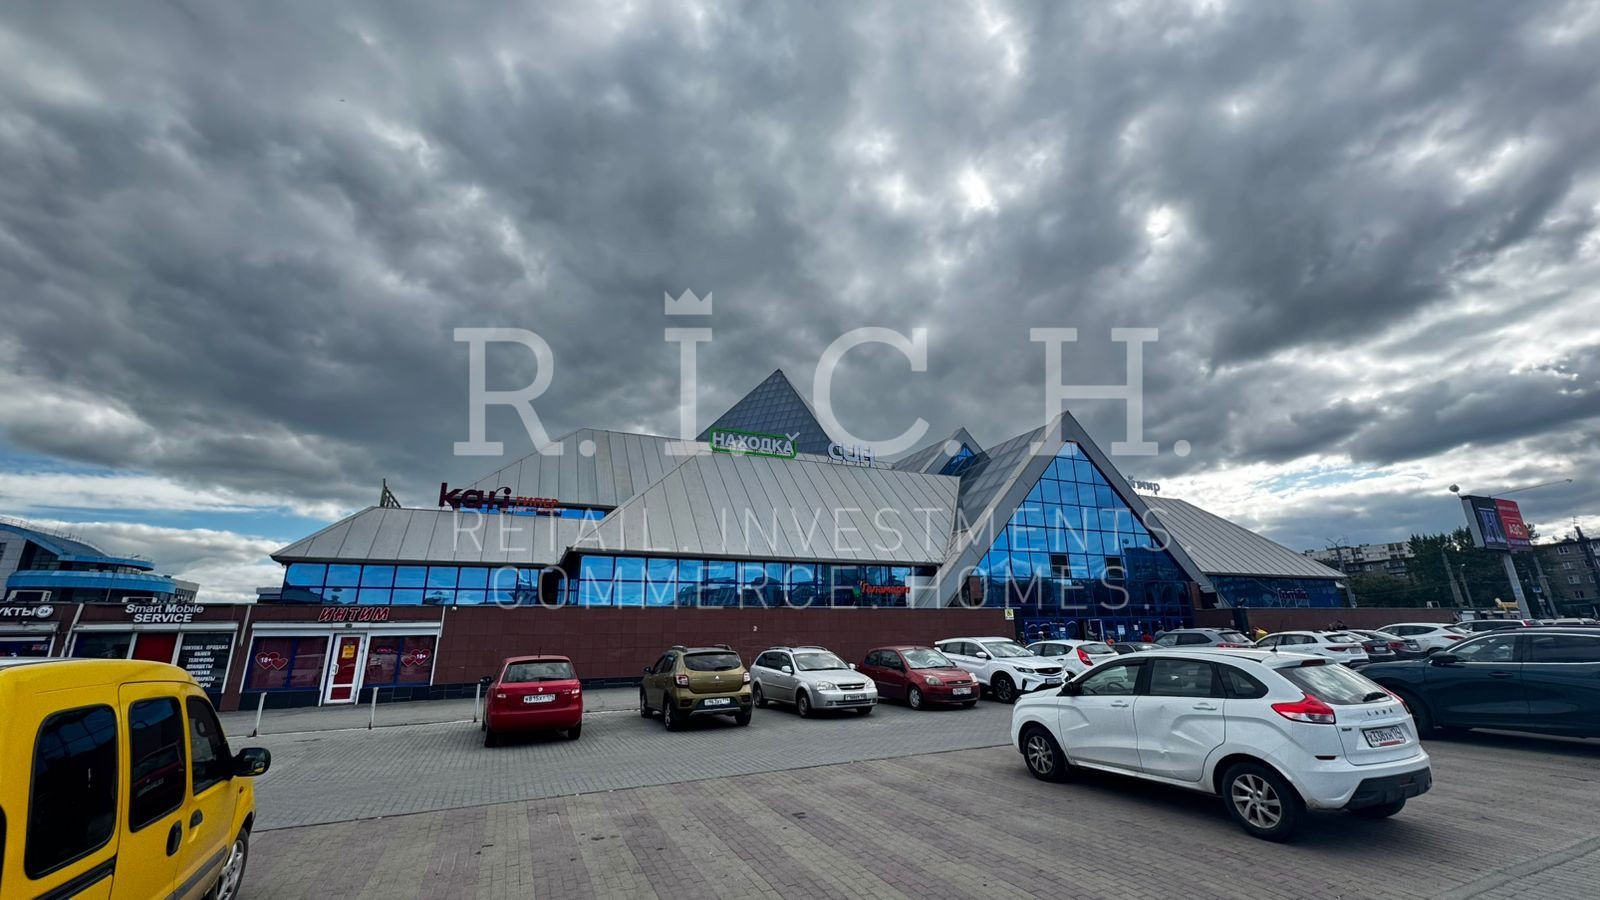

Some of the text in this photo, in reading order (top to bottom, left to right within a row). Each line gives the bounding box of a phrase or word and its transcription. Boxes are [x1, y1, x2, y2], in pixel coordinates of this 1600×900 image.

[712, 431, 794, 456] НАХОДКА
[438, 482, 511, 510] kari
[516, 496, 559, 509] ГИПЕР
[125, 603, 204, 614] Smart Mobile
[318, 606, 390, 622] ИНТИМ
[133, 613, 193, 623] SERVICE
[1366, 707, 1393, 716] LADA
